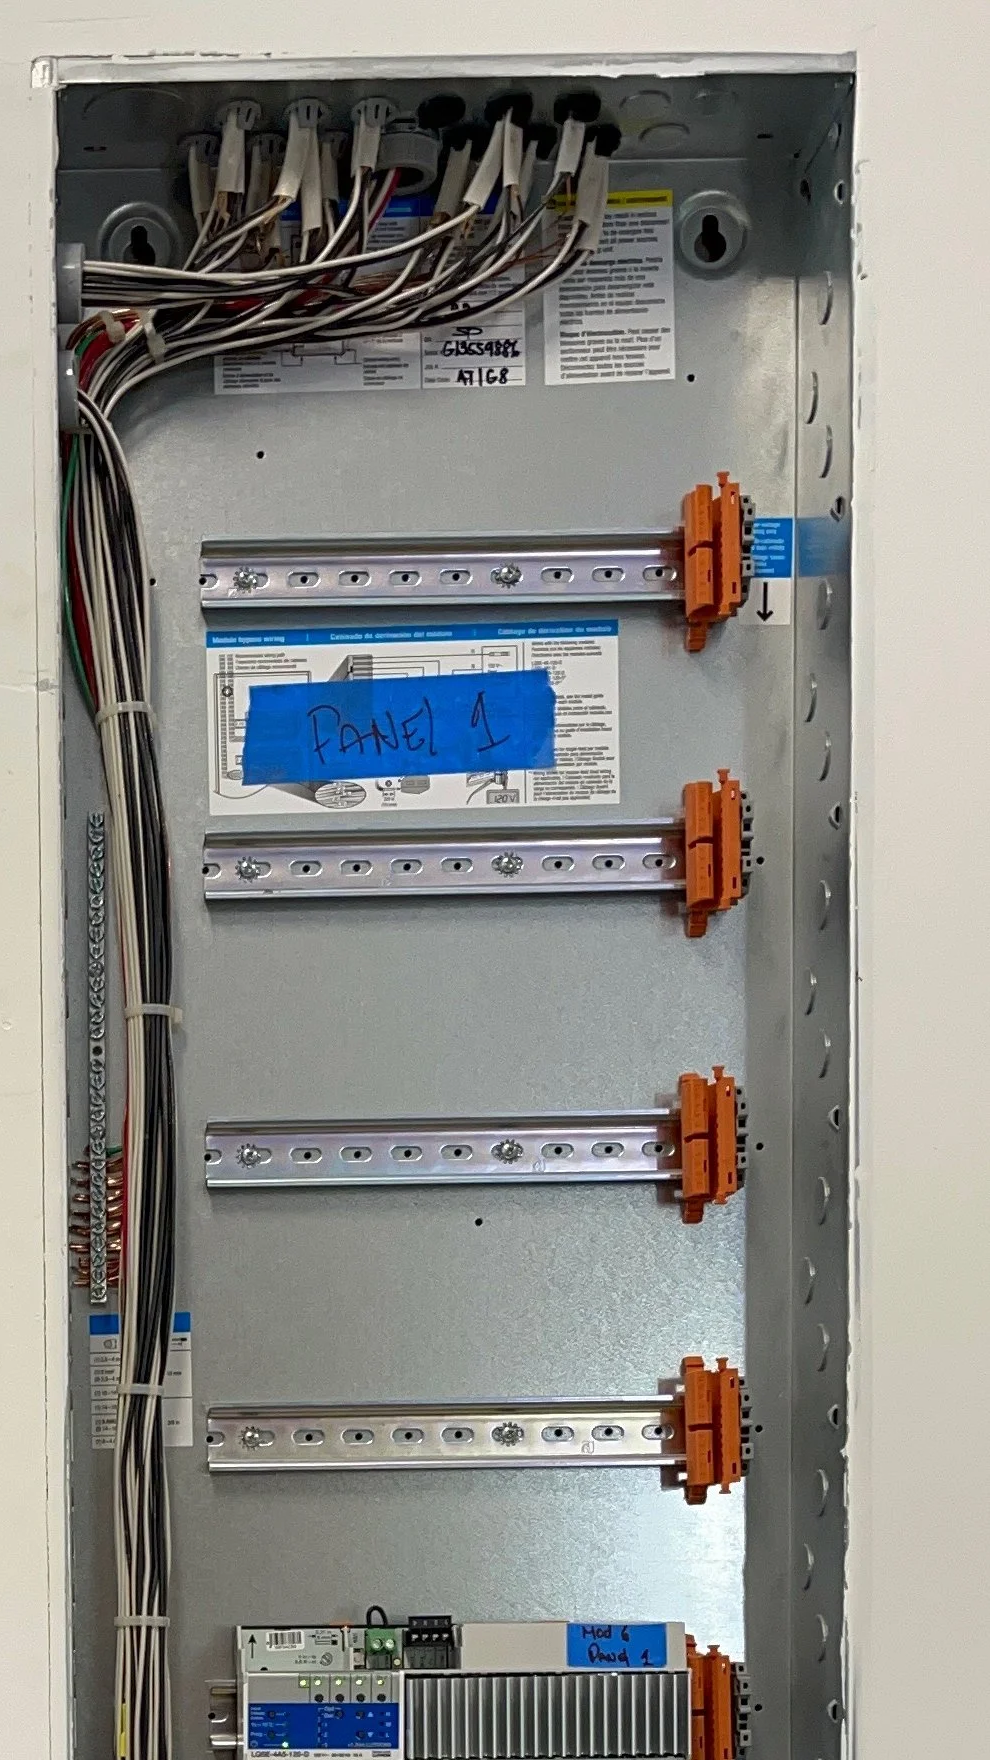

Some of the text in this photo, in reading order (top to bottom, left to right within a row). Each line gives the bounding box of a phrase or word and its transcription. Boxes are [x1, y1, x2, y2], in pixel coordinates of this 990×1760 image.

[470, 691, 511, 753] 1
[621, 1625, 630, 1642] 6
[640, 1649, 654, 1667] 1
